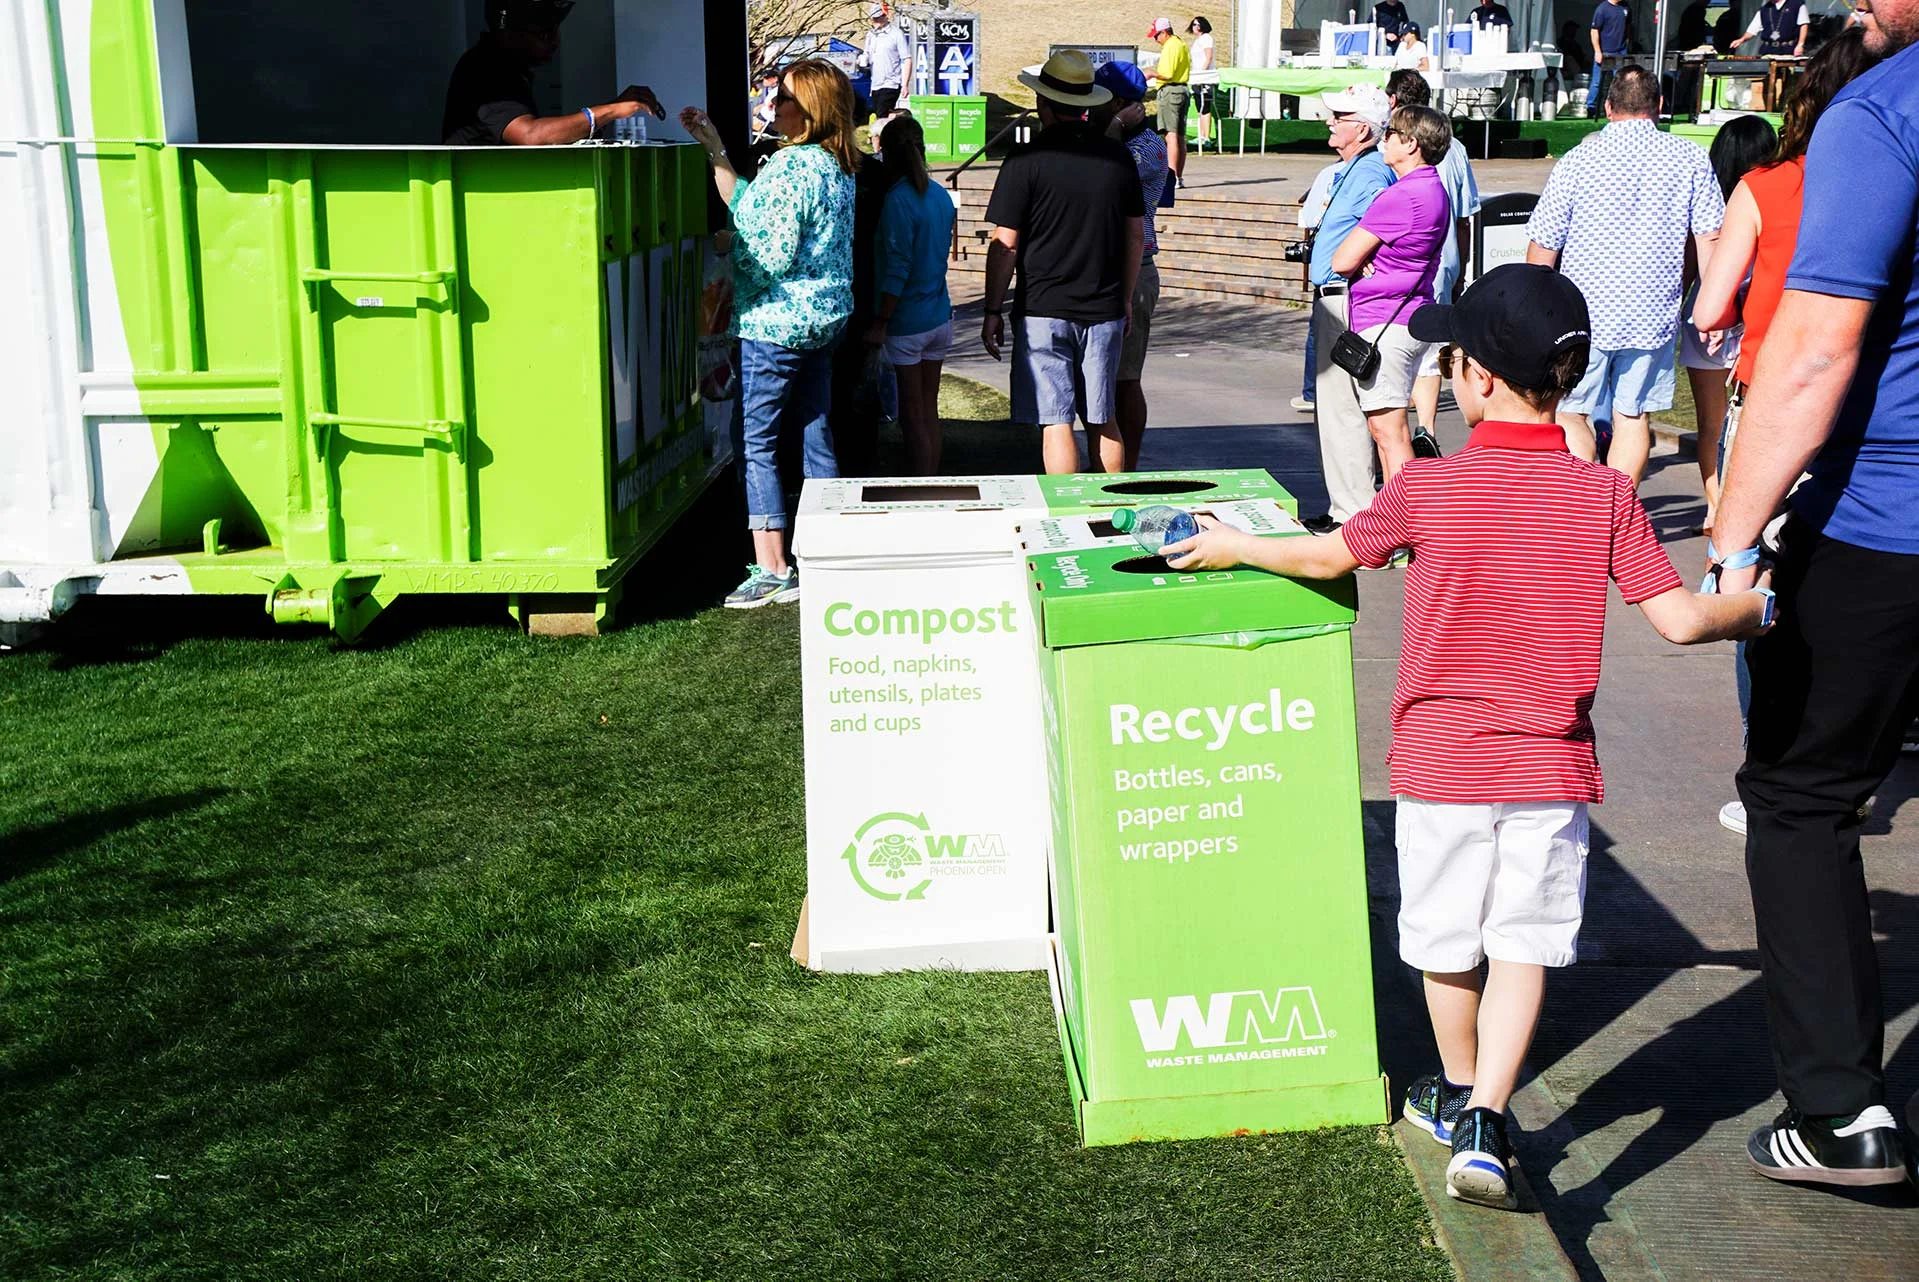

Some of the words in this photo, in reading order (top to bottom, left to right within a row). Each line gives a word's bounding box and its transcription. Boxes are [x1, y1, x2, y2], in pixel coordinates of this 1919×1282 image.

[823, 601, 1018, 644] Compost
[828, 655, 886, 676] Food,
[893, 654, 977, 677] napkins,
[829, 684, 914, 704] utensils,
[920, 683, 982, 706] plates
[830, 713, 867, 732] and
[874, 716, 922, 735] cups
[1109, 687, 1316, 751] Recycle
[1114, 764, 1212, 792] Bottles,
[1219, 762, 1283, 783] cans,
[1117, 804, 1190, 832] paper
[1199, 793, 1244, 820] and
[924, 833, 1007, 858] WM
[1119, 835, 1239, 863] wrappers
[929, 866, 975, 876] PHOENIX
[977, 865, 1007, 875] OPEN
[1128, 985, 1328, 1052] WM
[1146, 1054, 1203, 1069] WASTE
[1207, 1045, 1329, 1064] MANAGEMENT
